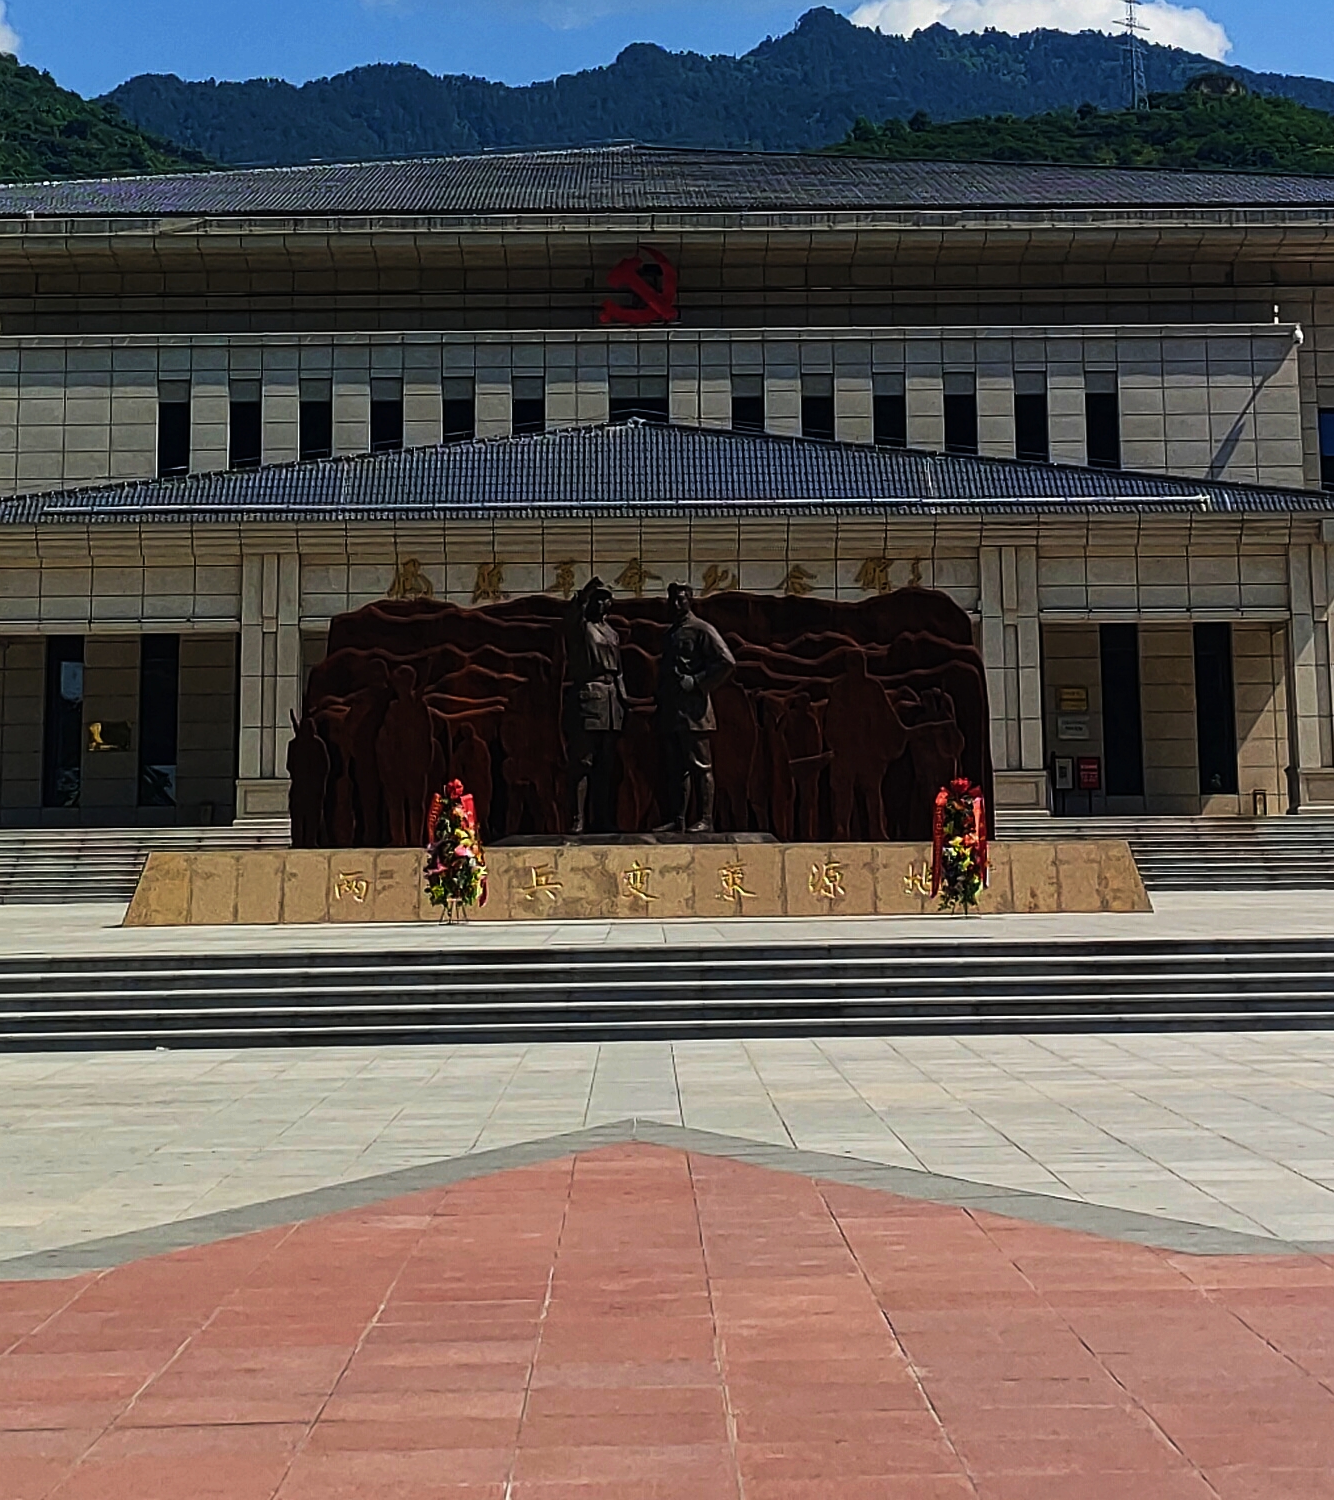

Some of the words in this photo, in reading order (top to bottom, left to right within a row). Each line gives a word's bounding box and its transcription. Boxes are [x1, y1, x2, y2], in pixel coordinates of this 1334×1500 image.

[334, 859, 945, 902] 两兵变策源地
